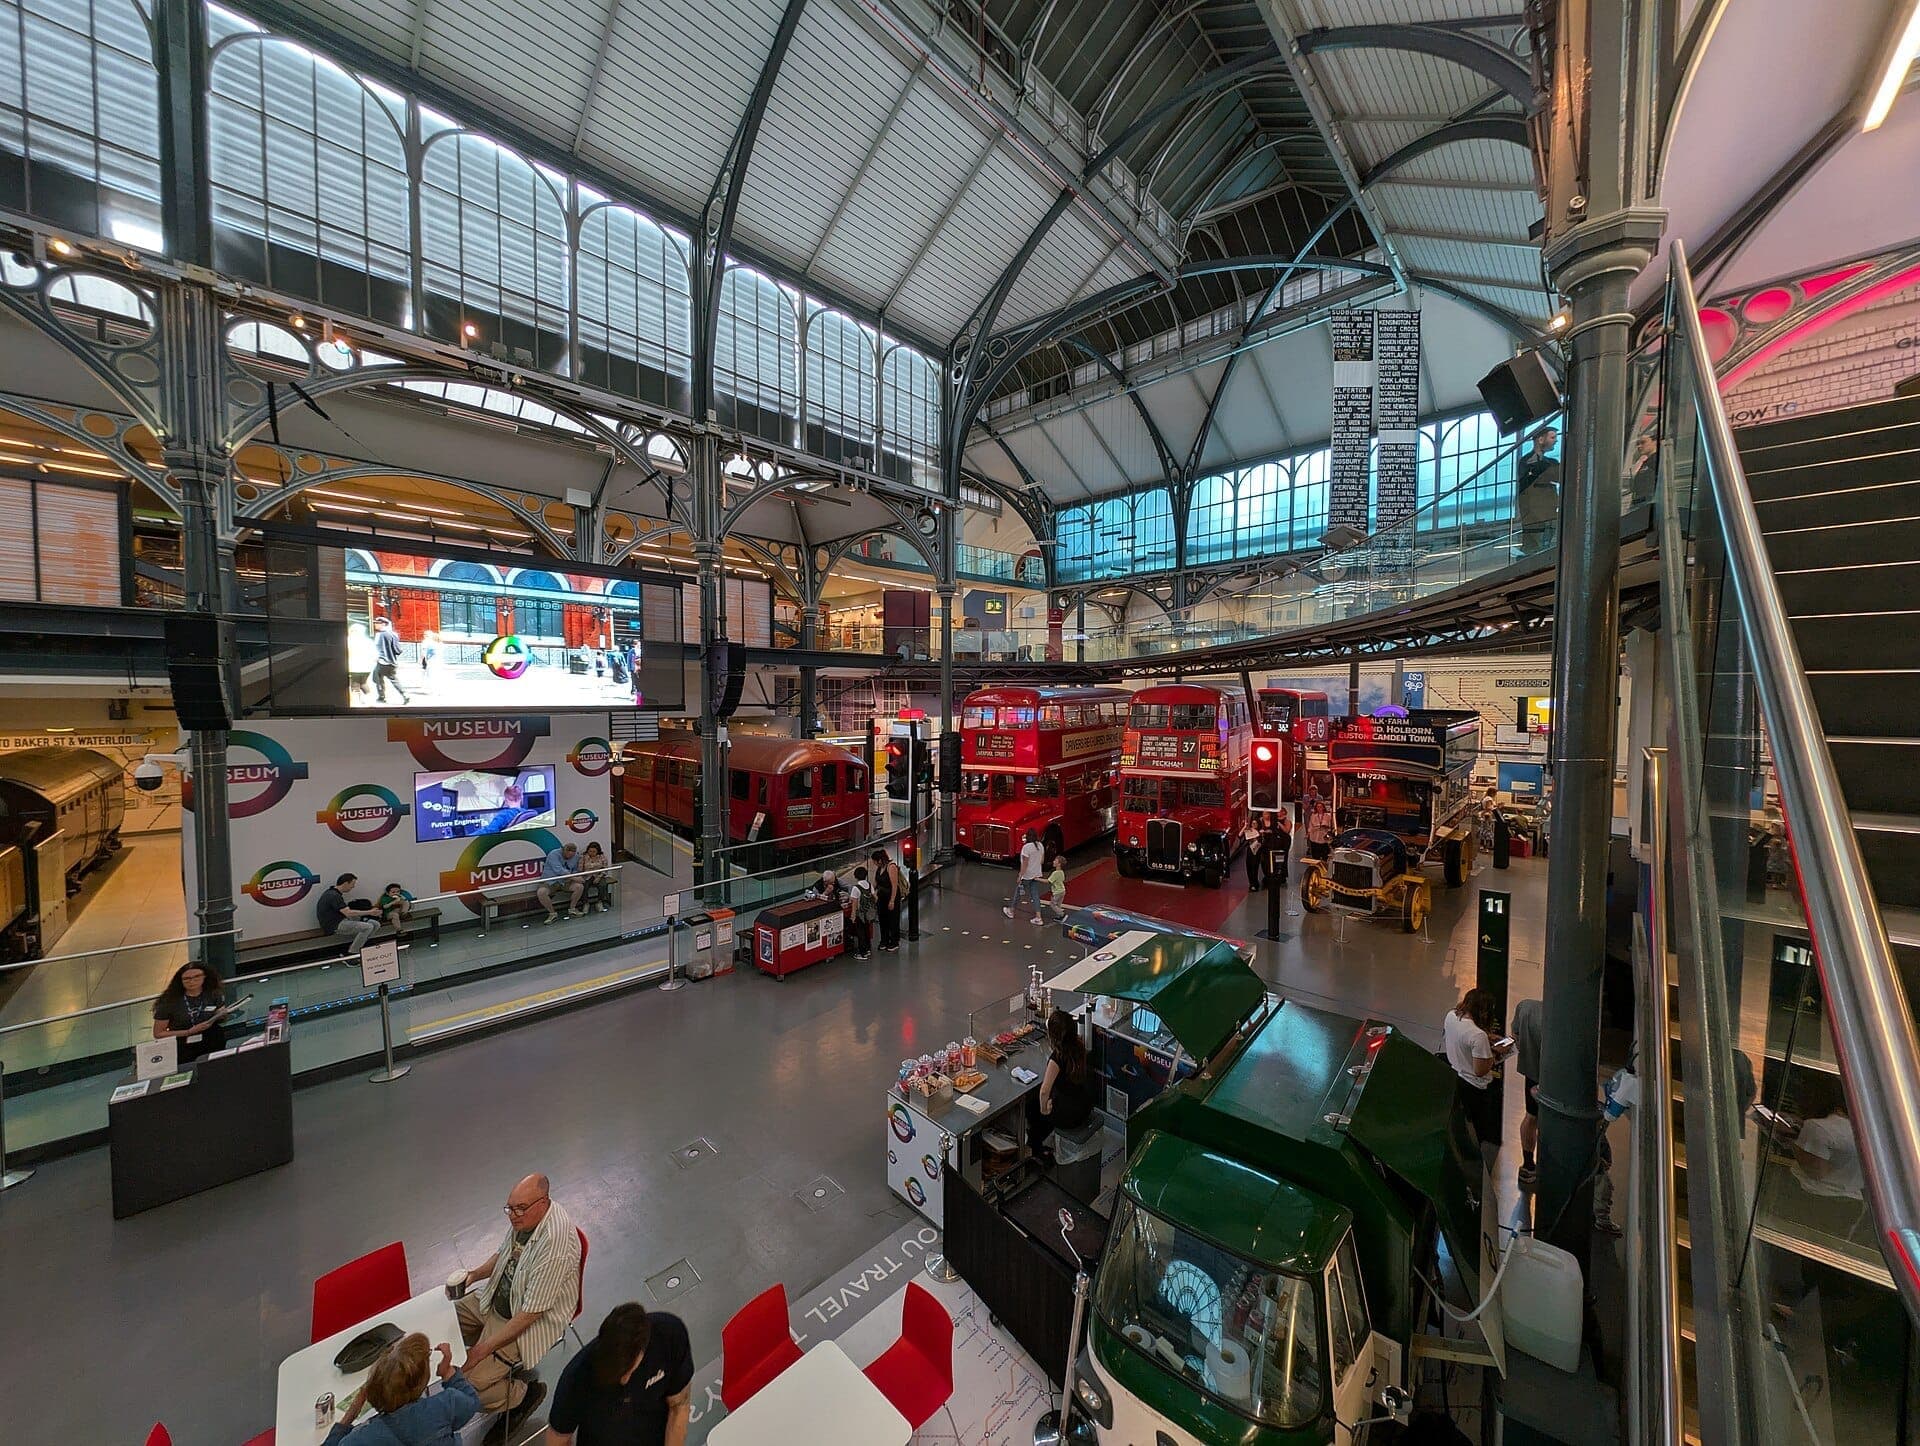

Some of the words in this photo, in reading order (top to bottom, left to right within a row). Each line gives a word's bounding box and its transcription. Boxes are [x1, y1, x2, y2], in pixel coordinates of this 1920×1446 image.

[424, 720, 521, 737] MUSEUM
[1348, 724, 1384, 733] STND.
[1386, 726, 1434, 734] HOLBORN.
[14, 738, 49, 748] BAKER
[53, 737, 66, 746] ST
[68, 737, 75, 746] &
[78, 736, 132, 746] WATERLOO
[1372, 734, 1406, 742] CAMDEN
[1182, 742, 1196, 753] 37
[577, 753, 610, 761] MUSEUM
[1152, 760, 1184, 768] PECKHAM
[336, 806, 393, 820] MUSEUM
[431, 820, 453, 828] Future
[470, 861, 544, 885] MUSEU
[257, 877, 306, 891] MUSEUM
[1486, 898, 1503, 914] 11
[1144, 1051, 1172, 1068] MUSEU
[901, 1227, 938, 1259] OU
[804, 1256, 903, 1324] TRAVEL
